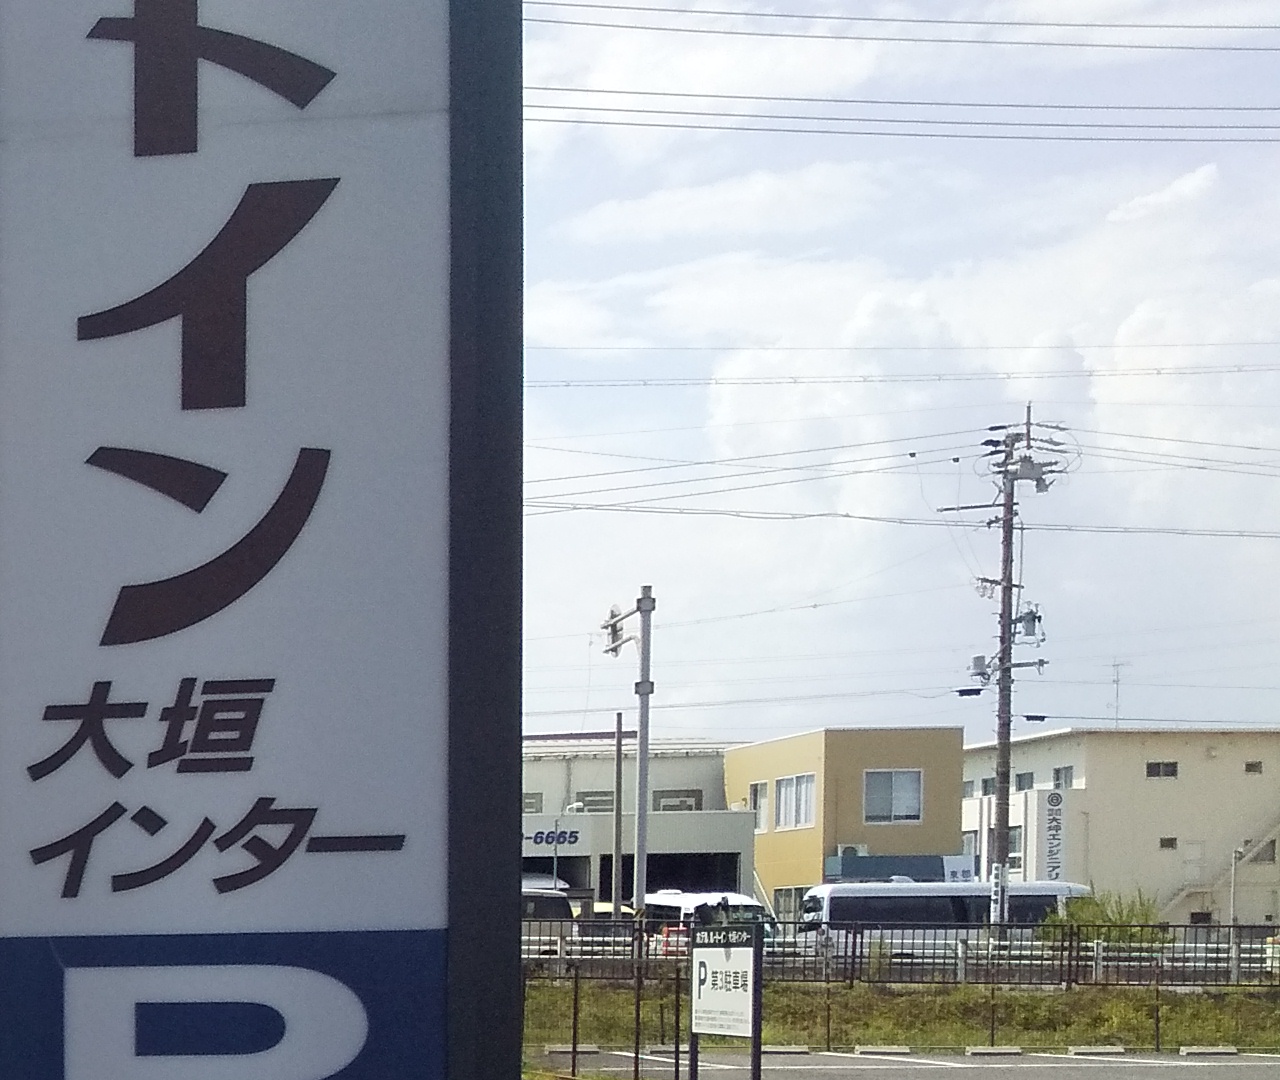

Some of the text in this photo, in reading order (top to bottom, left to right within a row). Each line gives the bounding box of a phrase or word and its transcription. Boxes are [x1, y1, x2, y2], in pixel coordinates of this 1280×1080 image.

[27, 678, 276, 782] 大垣
[29, 797, 407, 899] インター
[522, 830, 579, 845] -6665
[698, 960, 707, 999] P
